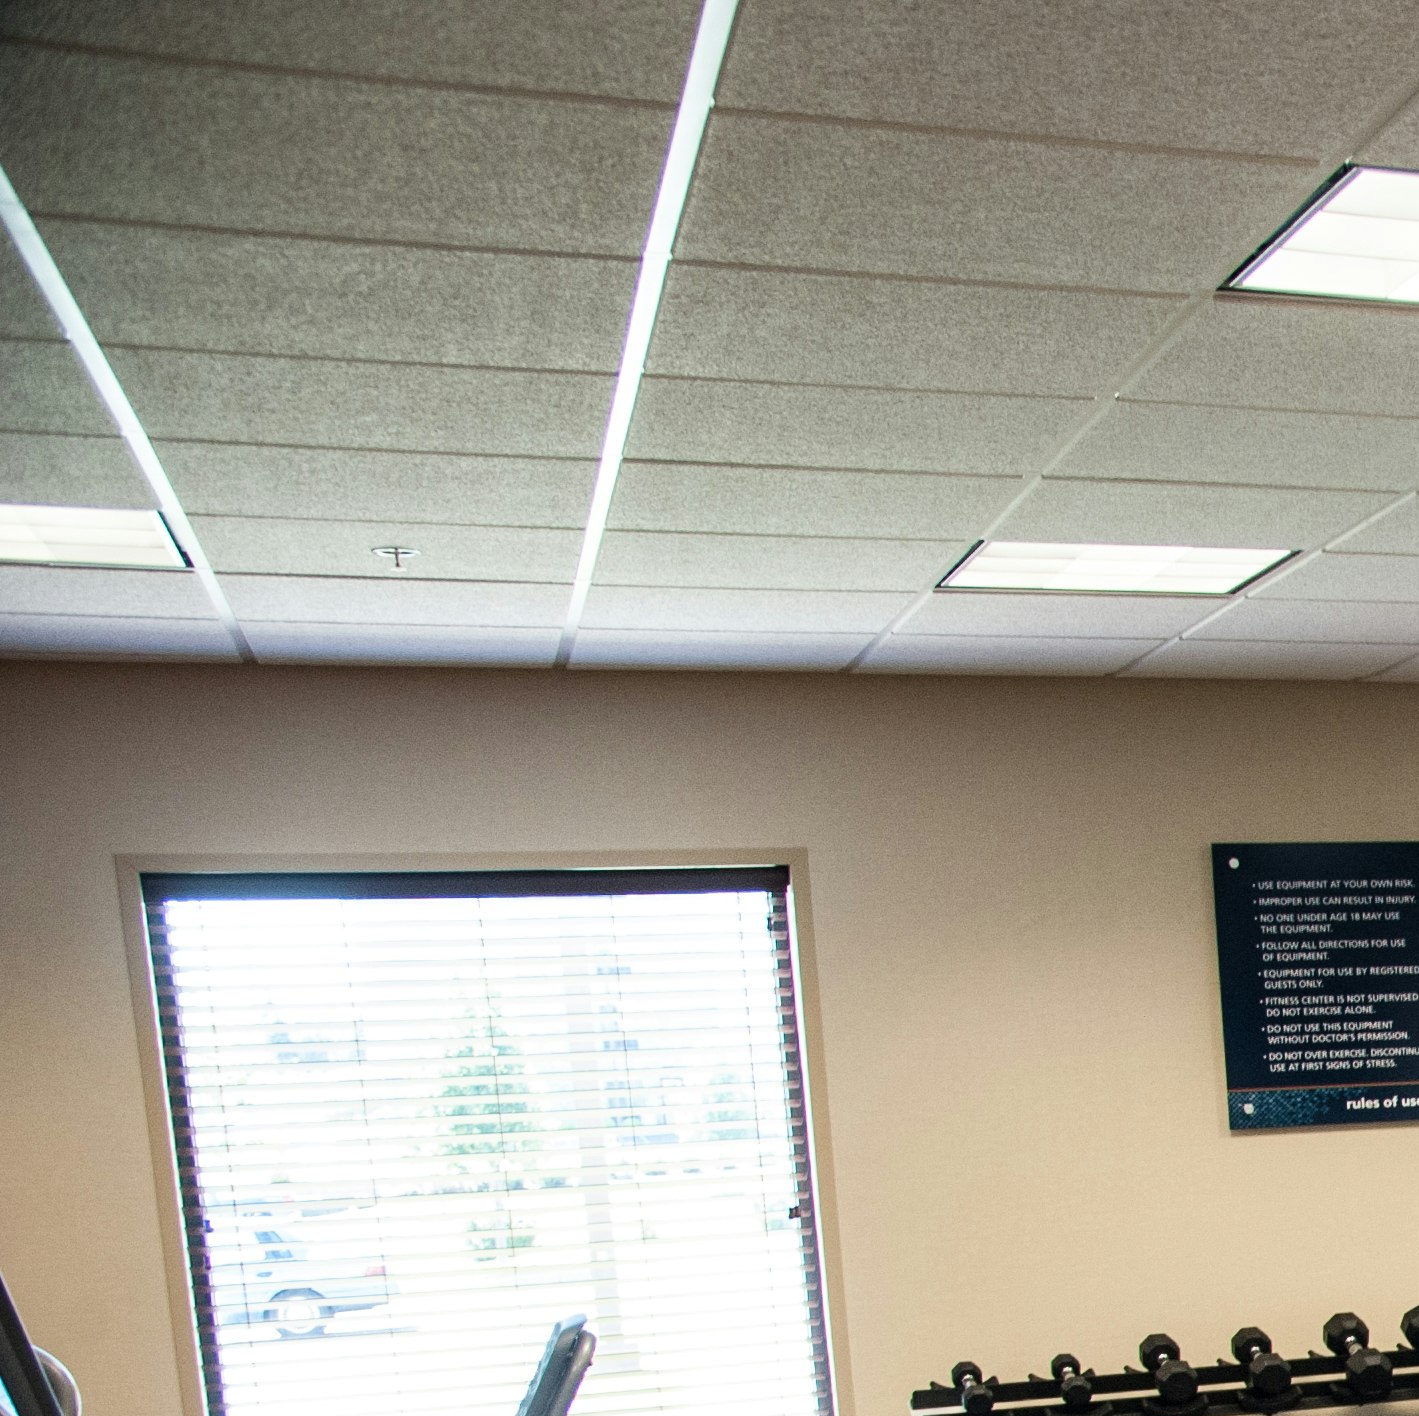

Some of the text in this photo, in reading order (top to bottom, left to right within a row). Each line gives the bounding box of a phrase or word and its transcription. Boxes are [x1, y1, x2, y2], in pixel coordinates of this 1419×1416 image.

[1258, 881, 1274, 890] USE
[1277, 880, 1327, 889] EQUIPMENT
[1331, 880, 1340, 889] AT
[1343, 880, 1367, 889] YOUR
[1371, 879, 1392, 888] OWN
[1259, 897, 1302, 906] IMPROPER
[1305, 897, 1320, 906] USE
[1323, 896, 1341, 905] CAN
[1343, 896, 1372, 905] RESULT
[1375, 896, 1383, 905] IN
[1260, 912, 1400, 922] NO ONE UNDER AGE 18 MAY USE
[1261, 925, 1277, 934] THE
[1262, 939, 1406, 950] FOLLOW ALL DIRECTIONS FOR USE
[1262, 953, 1274, 962] OF
[1264, 966, 1419, 978] EQUIPMENT FOR USE BY REGISTERED
[1264, 980, 1297, 989] GUESTS
[1265, 996, 1299, 1006] FITNESS
[1301, 995, 1334, 1005] CENTER
[1337, 995, 1344, 1004] IS
[1347, 995, 1365, 1004] NOT
[1266, 1008, 1280, 1017] DO
[1283, 1008, 1301, 1017] NOT
[1303, 1007, 1342, 1016] EXERCISE
[1267, 1020, 1393, 1034] DO NOT USE THIS EQUIPMENT
[1268, 1035, 1309, 1045] WITHOUT
[1269, 1052, 1282, 1061] DO
[1285, 1051, 1302, 1060] NOT
[1305, 1050, 1327, 1060] OVER
[1270, 1063, 1286, 1072] USE
[1288, 1063, 1299, 1072] AT
[1302, 1062, 1323, 1071] FIRST
[1326, 1061, 1351, 1070] SIGNS
[1353, 1060, 1364, 1069] OF
[1347, 1096, 1380, 1109] rules
[1383, 1096, 1398, 1108] of
